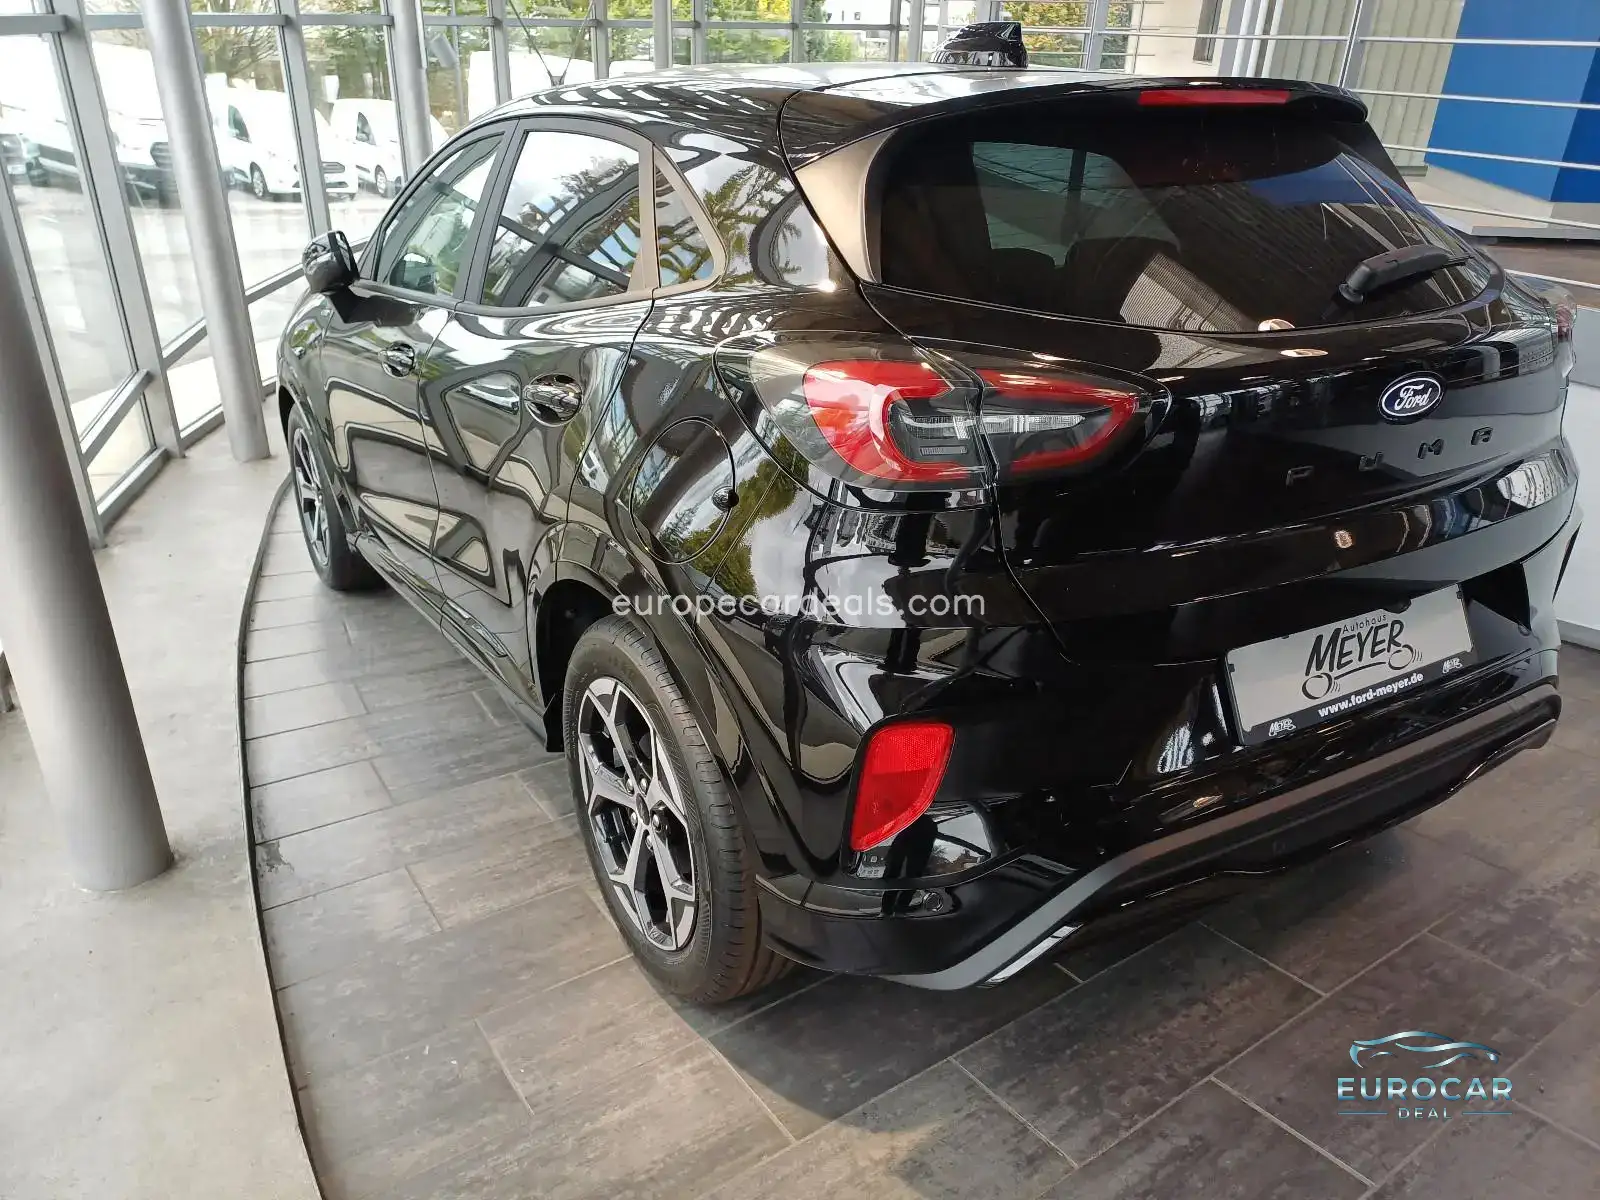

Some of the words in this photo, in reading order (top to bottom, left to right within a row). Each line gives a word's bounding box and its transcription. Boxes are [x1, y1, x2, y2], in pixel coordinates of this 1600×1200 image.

[1394, 384, 1432, 410] Ford
[1286, 426, 1494, 487] PUMA
[1342, 614, 1387, 634] Autohaus
[1305, 619, 1405, 676] MEYER
[1317, 672, 1424, 718] www.ford-meyer.de
